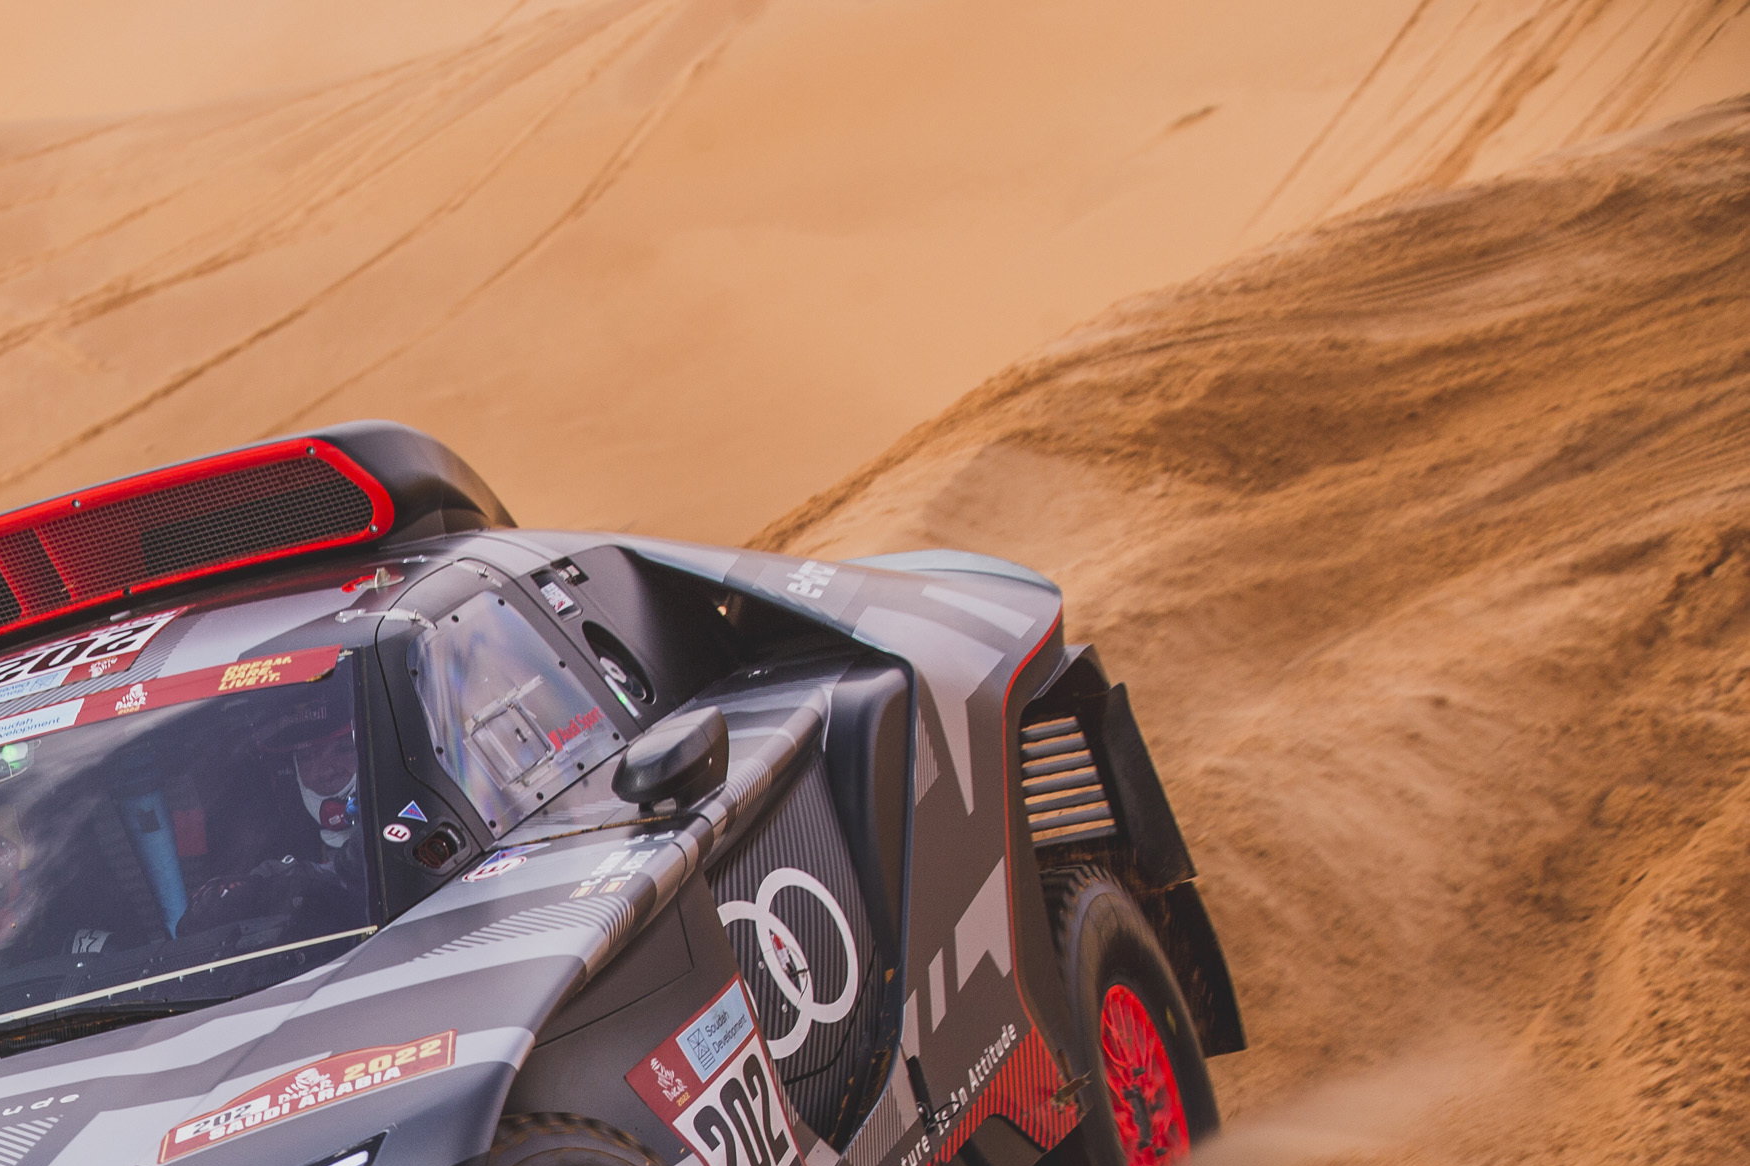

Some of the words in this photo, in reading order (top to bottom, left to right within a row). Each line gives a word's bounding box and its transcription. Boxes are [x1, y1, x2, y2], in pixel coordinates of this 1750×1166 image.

[704, 1010, 730, 1037] Soudah
[712, 1013, 747, 1055] Development
[343, 1038, 443, 1083] 2022
[933, 1110, 951, 1136] Is
[949, 1086, 969, 1113] An
[967, 1023, 1018, 1093] Attitude
[191, 1104, 252, 1134] 202
[208, 1103, 291, 1141] SAUDI
[298, 1066, 402, 1109] ARABIA
